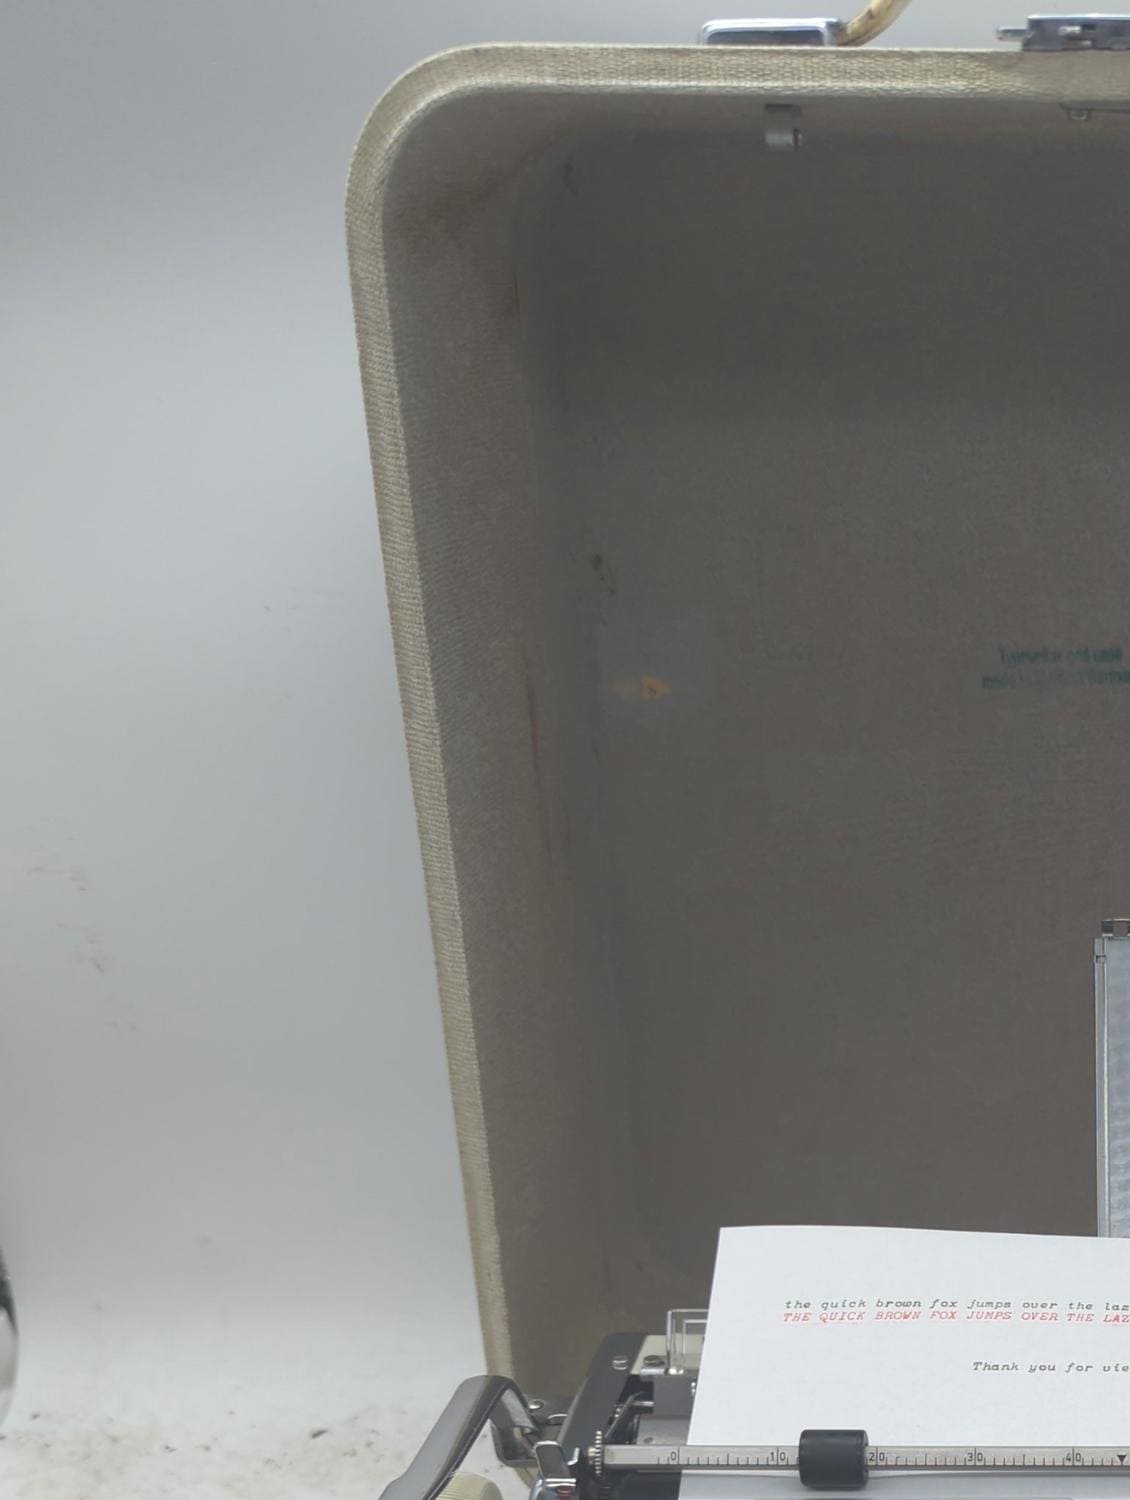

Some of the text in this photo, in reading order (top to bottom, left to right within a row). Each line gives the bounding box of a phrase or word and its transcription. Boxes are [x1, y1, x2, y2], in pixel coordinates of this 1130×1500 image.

[785, 1300, 811, 1309] the
[821, 1299, 867, 1311] quick
[876, 1299, 922, 1308] brown
[929, 1299, 957, 1310] fox
[967, 1300, 1011, 1311] jumps
[1068, 1301, 1093, 1310] the
[784, 1312, 811, 1322] THE
[819, 1311, 866, 1323] QUICK
[875, 1311, 921, 1320] BROWN
[929, 1311, 957, 1320] FOX
[966, 1311, 1012, 1320] JUMPS
[1021, 1312, 1058, 1321] OVER
[1066, 1313, 1094, 1322] THE
[973, 1361, 1019, 1371] Thank
[1028, 1363, 1056, 1374] you
[1065, 1362, 1094, 1373] for
[670, 1452, 677, 1461] 0
